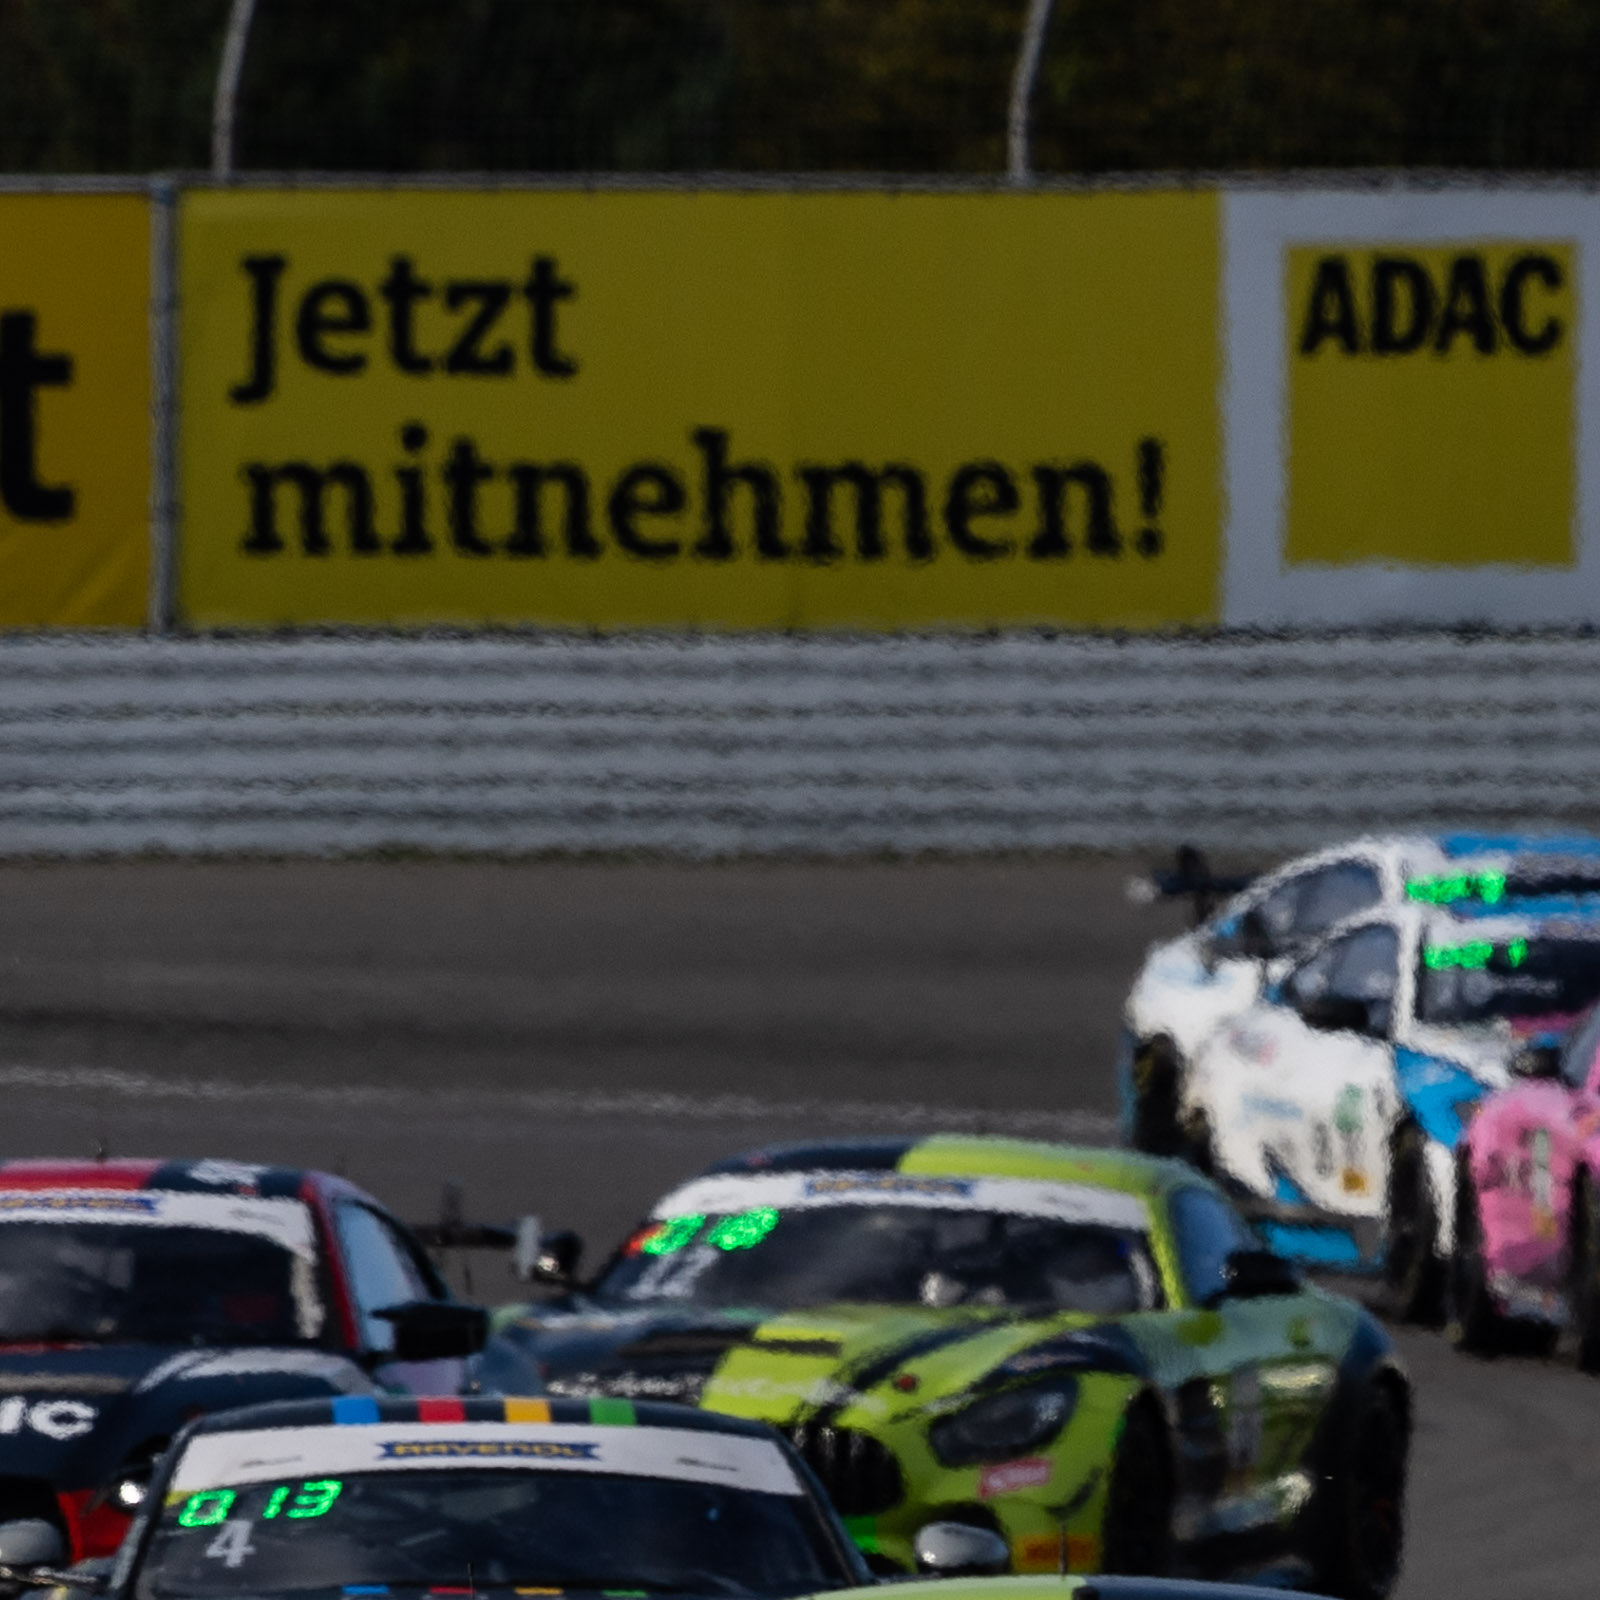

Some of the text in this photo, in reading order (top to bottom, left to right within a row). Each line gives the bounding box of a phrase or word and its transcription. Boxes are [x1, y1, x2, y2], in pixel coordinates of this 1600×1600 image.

[230, 252, 578, 404] Jetzt
[1300, 252, 1563, 358] ADAC
[240, 421, 1165, 565] mitnehmen!
[178, 1479, 343, 1527] 013
[206, 1519, 257, 1569] 4
